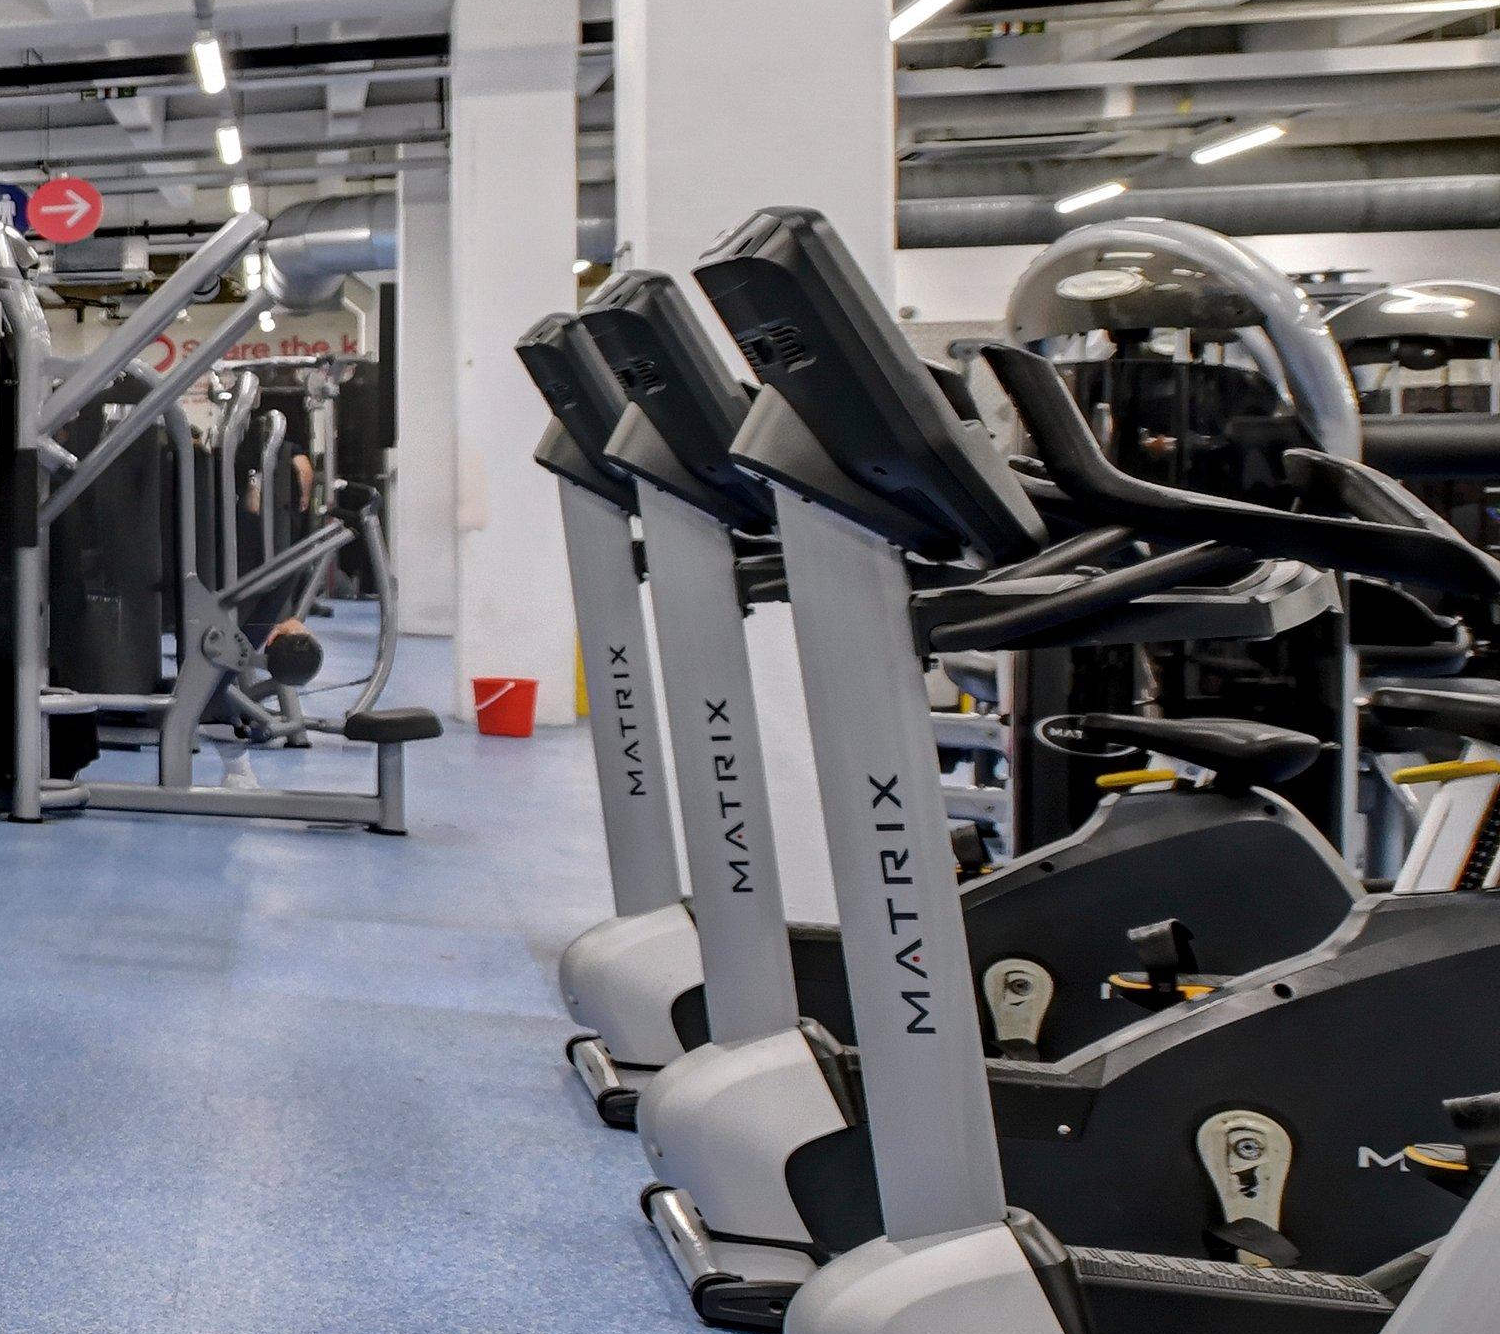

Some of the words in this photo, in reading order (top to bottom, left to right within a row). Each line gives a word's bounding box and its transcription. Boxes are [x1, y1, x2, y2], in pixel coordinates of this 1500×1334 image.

[281, 335, 331, 357] the
[609, 644, 647, 797] MATRIX
[705, 697, 754, 894] MATRIX
[868, 774, 937, 1035] MATRIX
